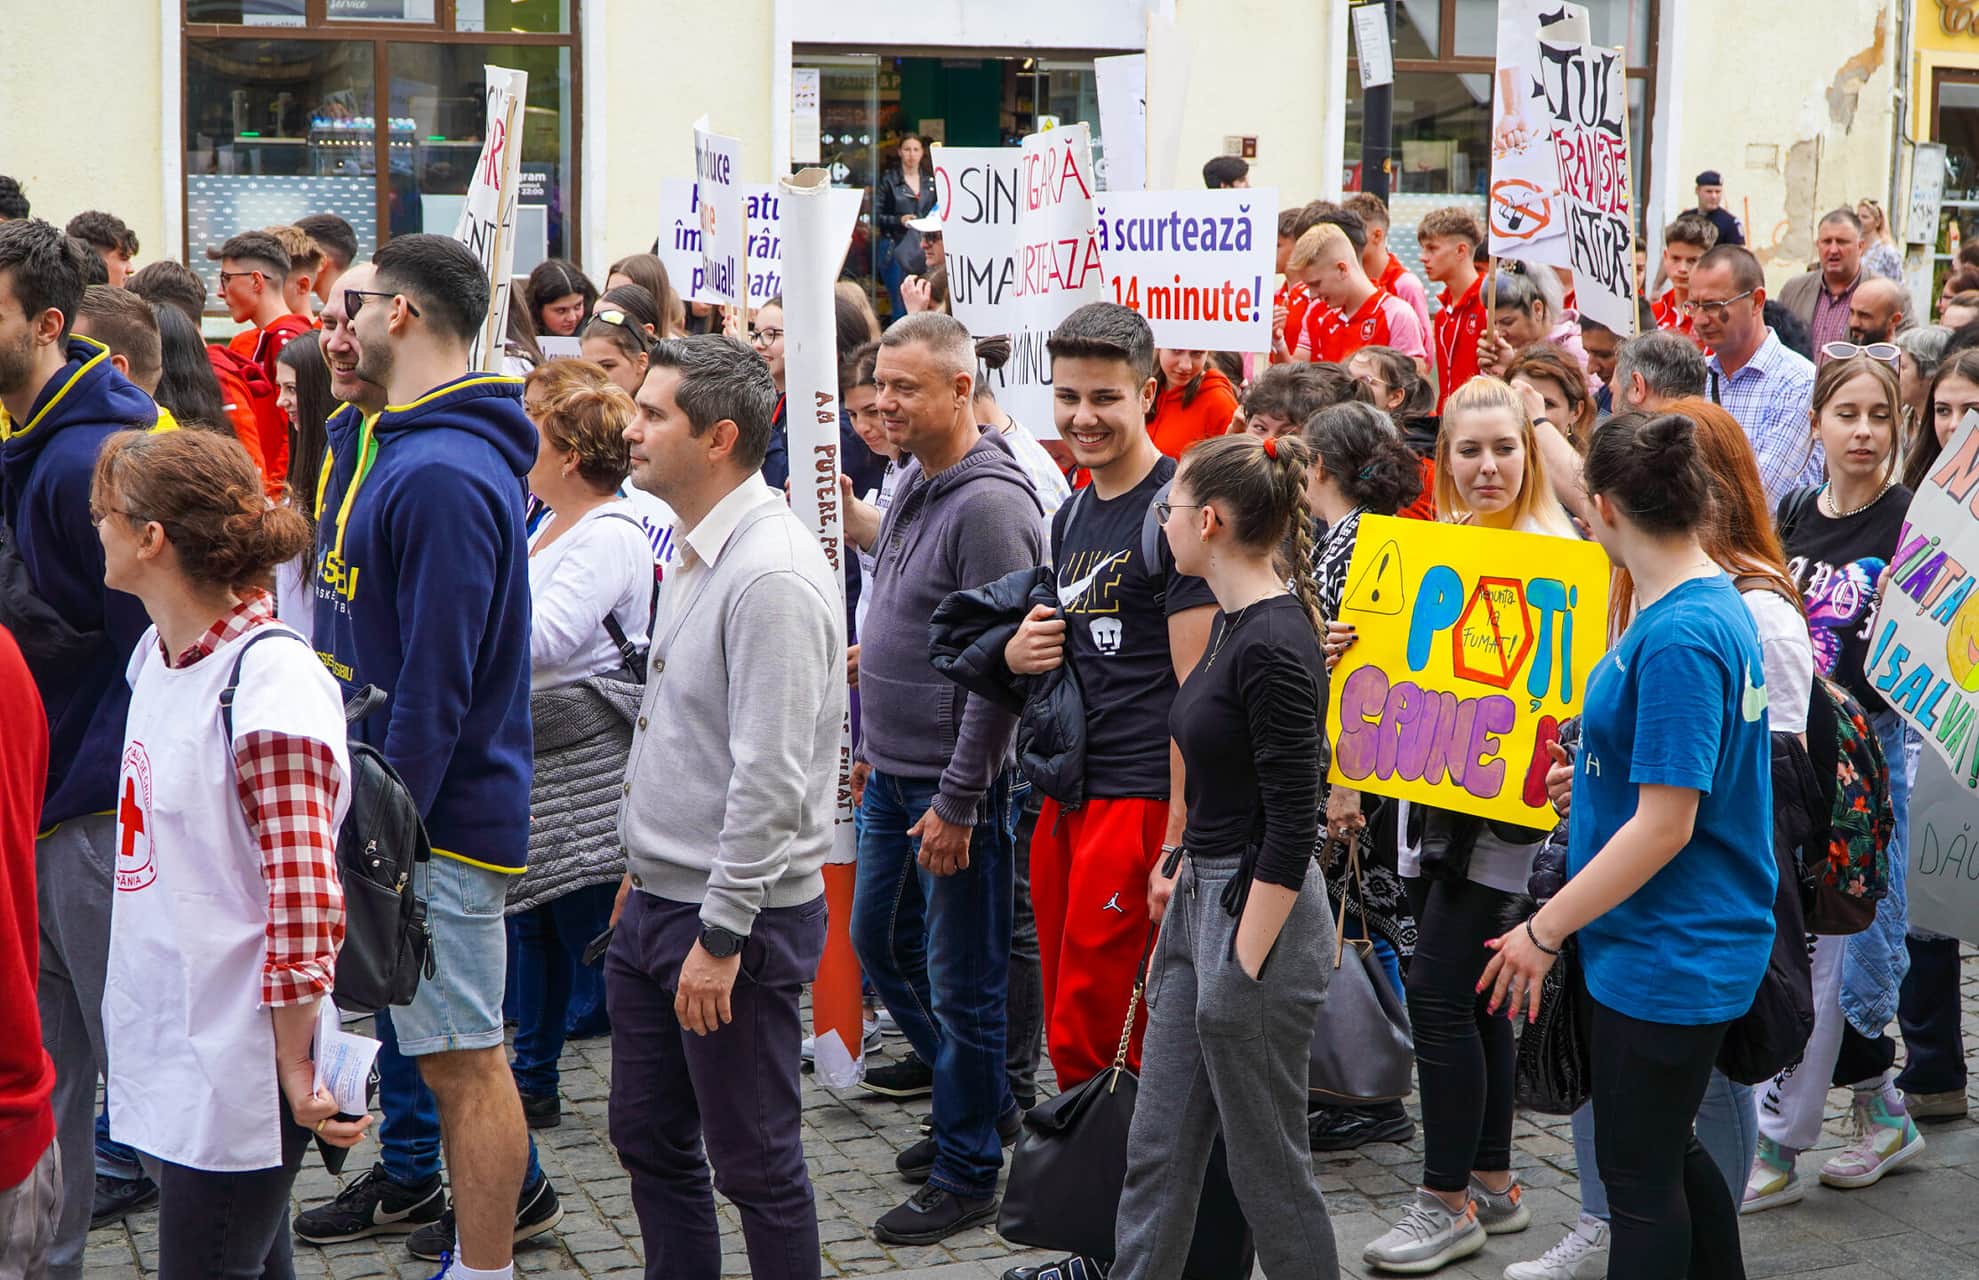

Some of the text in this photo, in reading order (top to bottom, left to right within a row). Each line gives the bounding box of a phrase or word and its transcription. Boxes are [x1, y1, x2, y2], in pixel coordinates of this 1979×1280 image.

[1115, 203, 1252, 252] scurtează
[1147, 273, 1262, 323] minute!
[814, 391, 835, 424] AM
